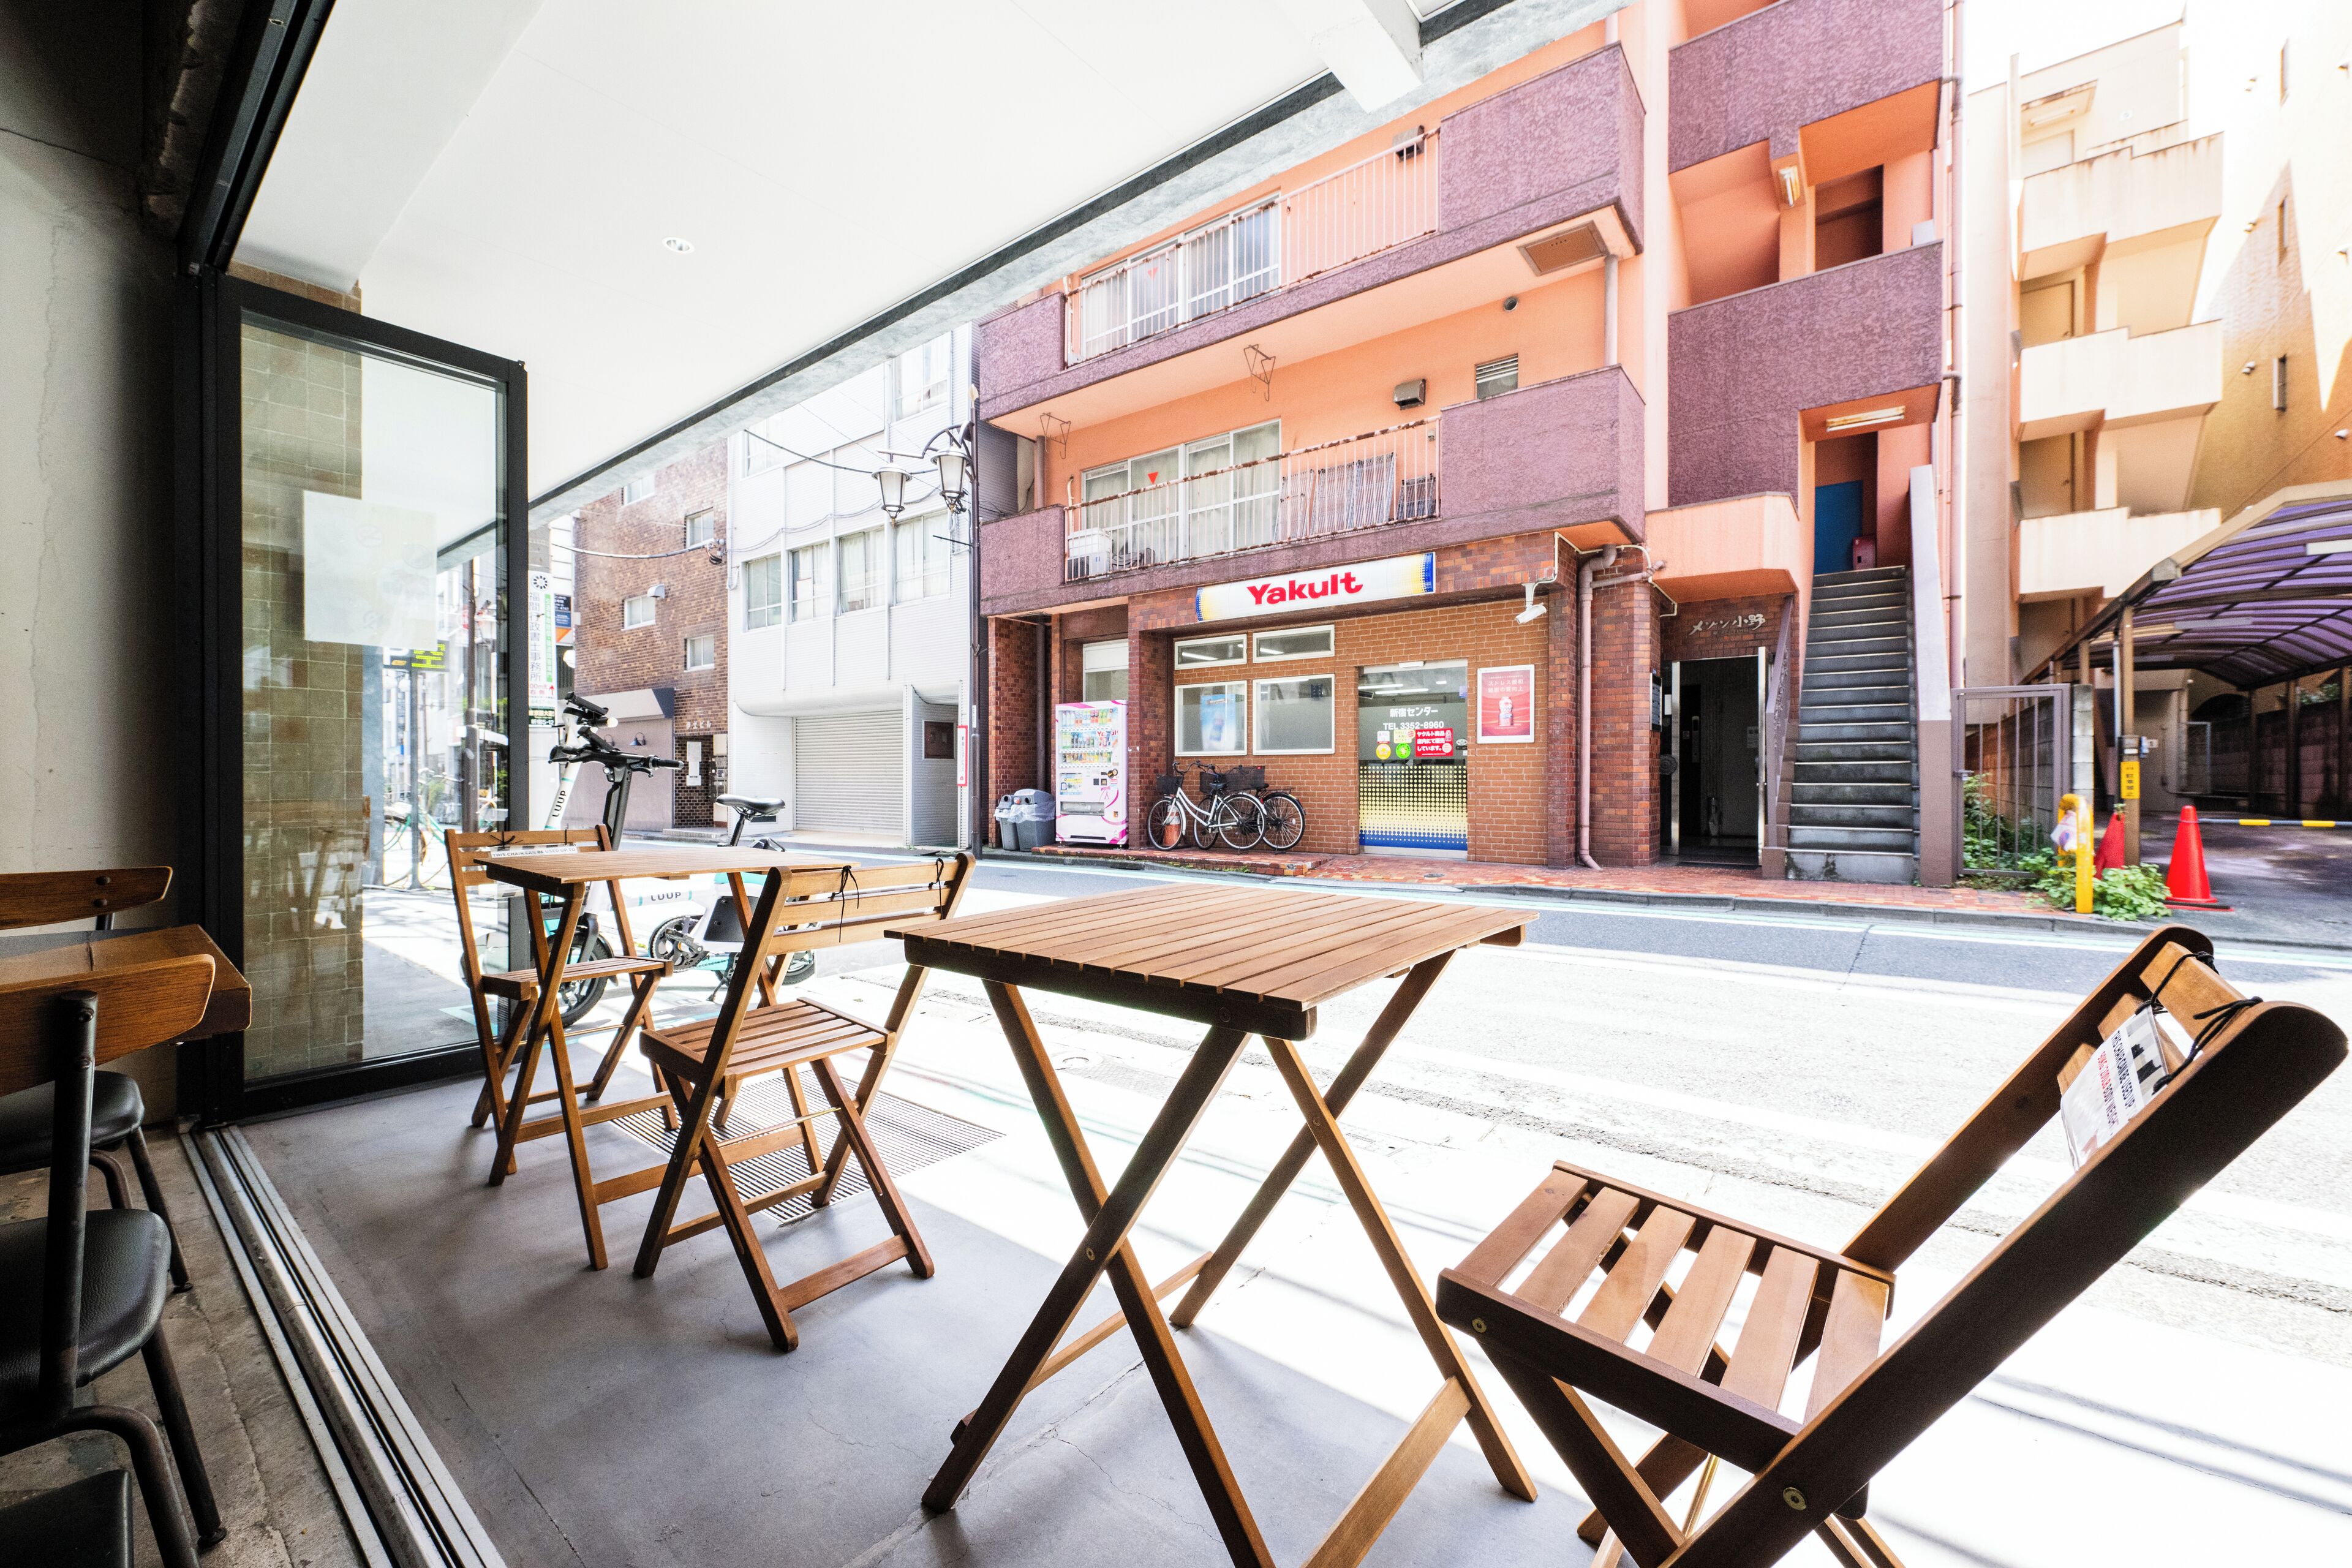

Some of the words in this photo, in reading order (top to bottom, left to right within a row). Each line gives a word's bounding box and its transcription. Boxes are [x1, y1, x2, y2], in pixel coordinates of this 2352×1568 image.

[1246, 571, 1363, 605] Yakult
[1689, 613, 1766, 636] メゾン小野
[1390, 706, 1438, 717] 新宿センター
[1400, 721, 1444, 729] 3352-8960
[552, 790, 567, 817] LUUP
[650, 892, 682, 901] LUUP
[2112, 1030, 2122, 1047] THIS
[2114, 1042, 2125, 1063] CHAIR
[2117, 1057, 2127, 1074] CAN
[2097, 1051, 2106, 1069] 90KG
[2103, 1084, 2114, 1105] BODY
[2120, 1069, 2129, 1083] BE
[2122, 1078, 2132, 1099] USED
[2125, 1096, 2134, 1109] UP
